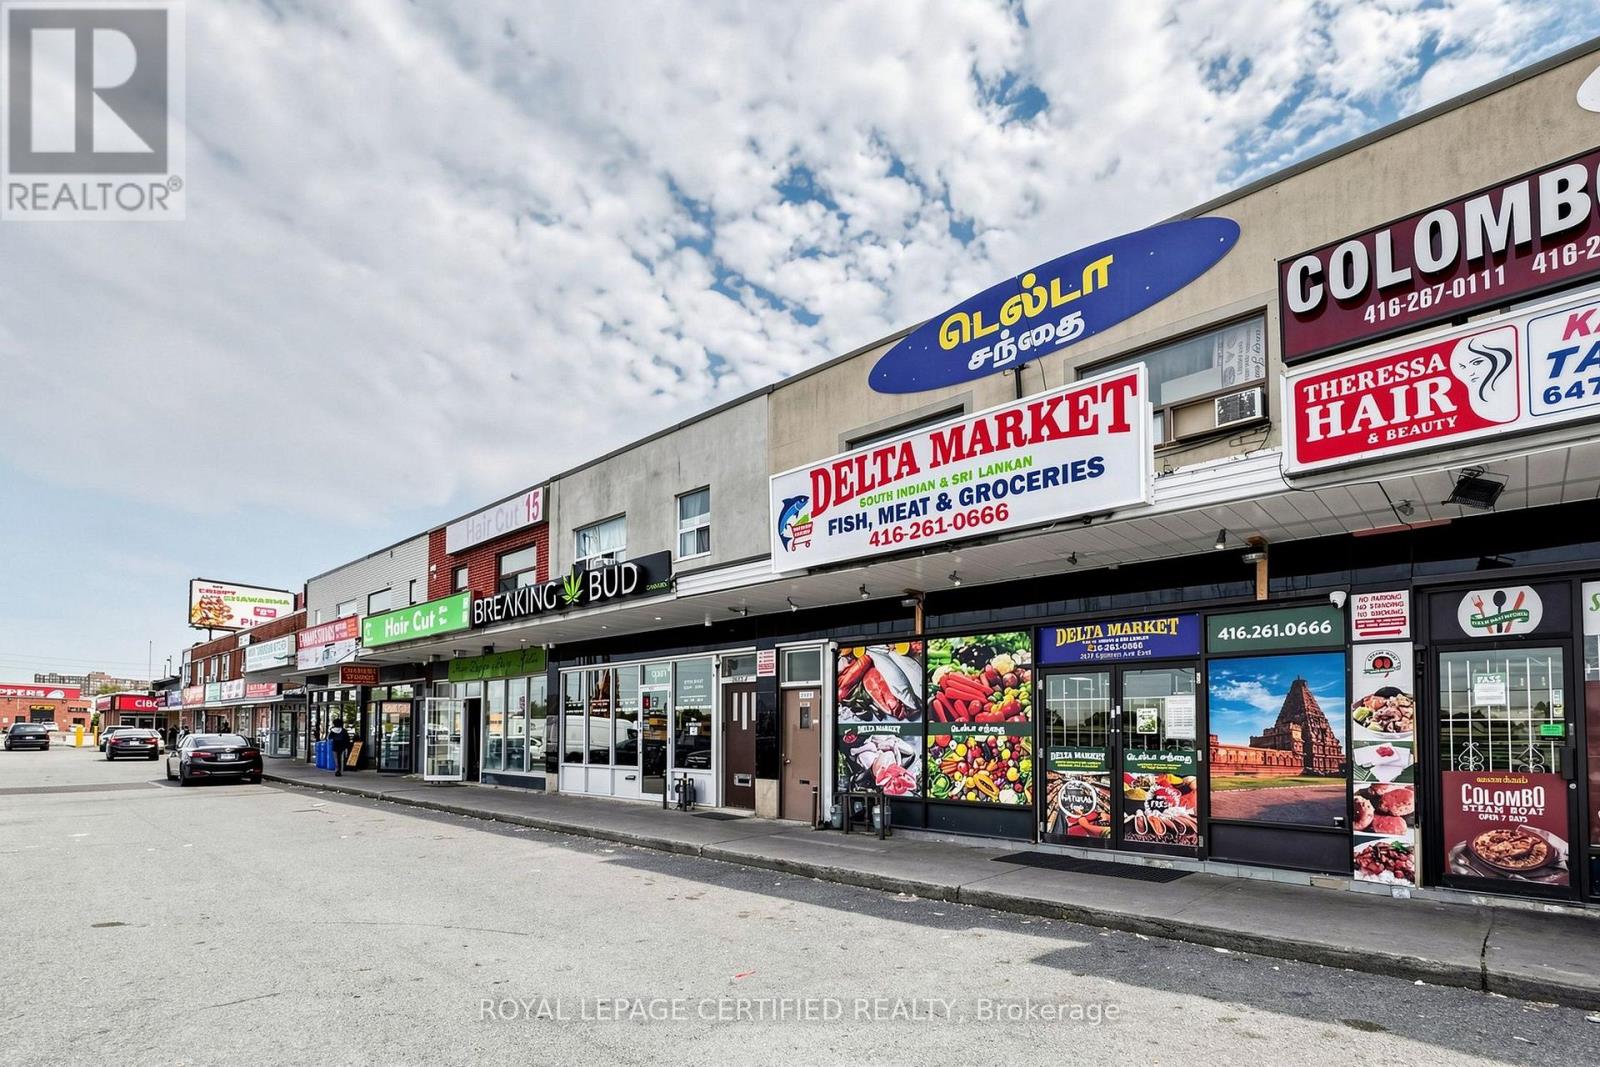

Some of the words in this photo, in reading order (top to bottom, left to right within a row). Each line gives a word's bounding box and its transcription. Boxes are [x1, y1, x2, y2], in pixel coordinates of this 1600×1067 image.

[1286, 162, 1600, 314] COLOMB
[938, 253, 1114, 351] டெல்டா
[1364, 265, 1505, 324] 416-267-0111
[967, 310, 1085, 371] சந்தை
[1303, 353, 1447, 404] THERESSA
[1305, 375, 1457, 443] HAIR
[1367, 432, 1380, 445] &
[1386, 415, 1458, 442] BEAUTY
[809, 440, 920, 518] DELTA
[929, 374, 1138, 468] MARKET
[828, 510, 874, 537] FISH,
[878, 499, 929, 526] MEAT
[935, 491, 953, 512] &
[958, 455, 1106, 505] GROCERIES
[859, 490, 893, 509] SOUTH
[897, 482, 937, 500] INDIAN
[940, 477, 949, 489] &
[951, 470, 973, 486] SRI
[978, 455, 1033, 480] LANKAN
[466, 514, 492, 544] Hair
[495, 507, 520, 532] Cut
[525, 491, 540, 522] 15
[869, 502, 1010, 548] 416-261-0666
[474, 580, 557, 625] BREAKING
[589, 562, 638, 602] BUD
[384, 615, 409, 638] Hair
[412, 610, 436, 632] Cut
[1055, 624, 1104, 647] DELTA
[1107, 617, 1180, 637] MARKET
[1217, 620, 1333, 641] 416.261.0666
[1050, 752, 1073, 761] DELTA
[1074, 751, 1106, 761] MARKET
[1461, 783, 1545, 808] COLOMBO
[1462, 804, 1504, 814] STEAM
[1510, 806, 1545, 816] BOAT
[1501, 814, 1507, 822] 7
[1508, 815, 1528, 823] DAYS
